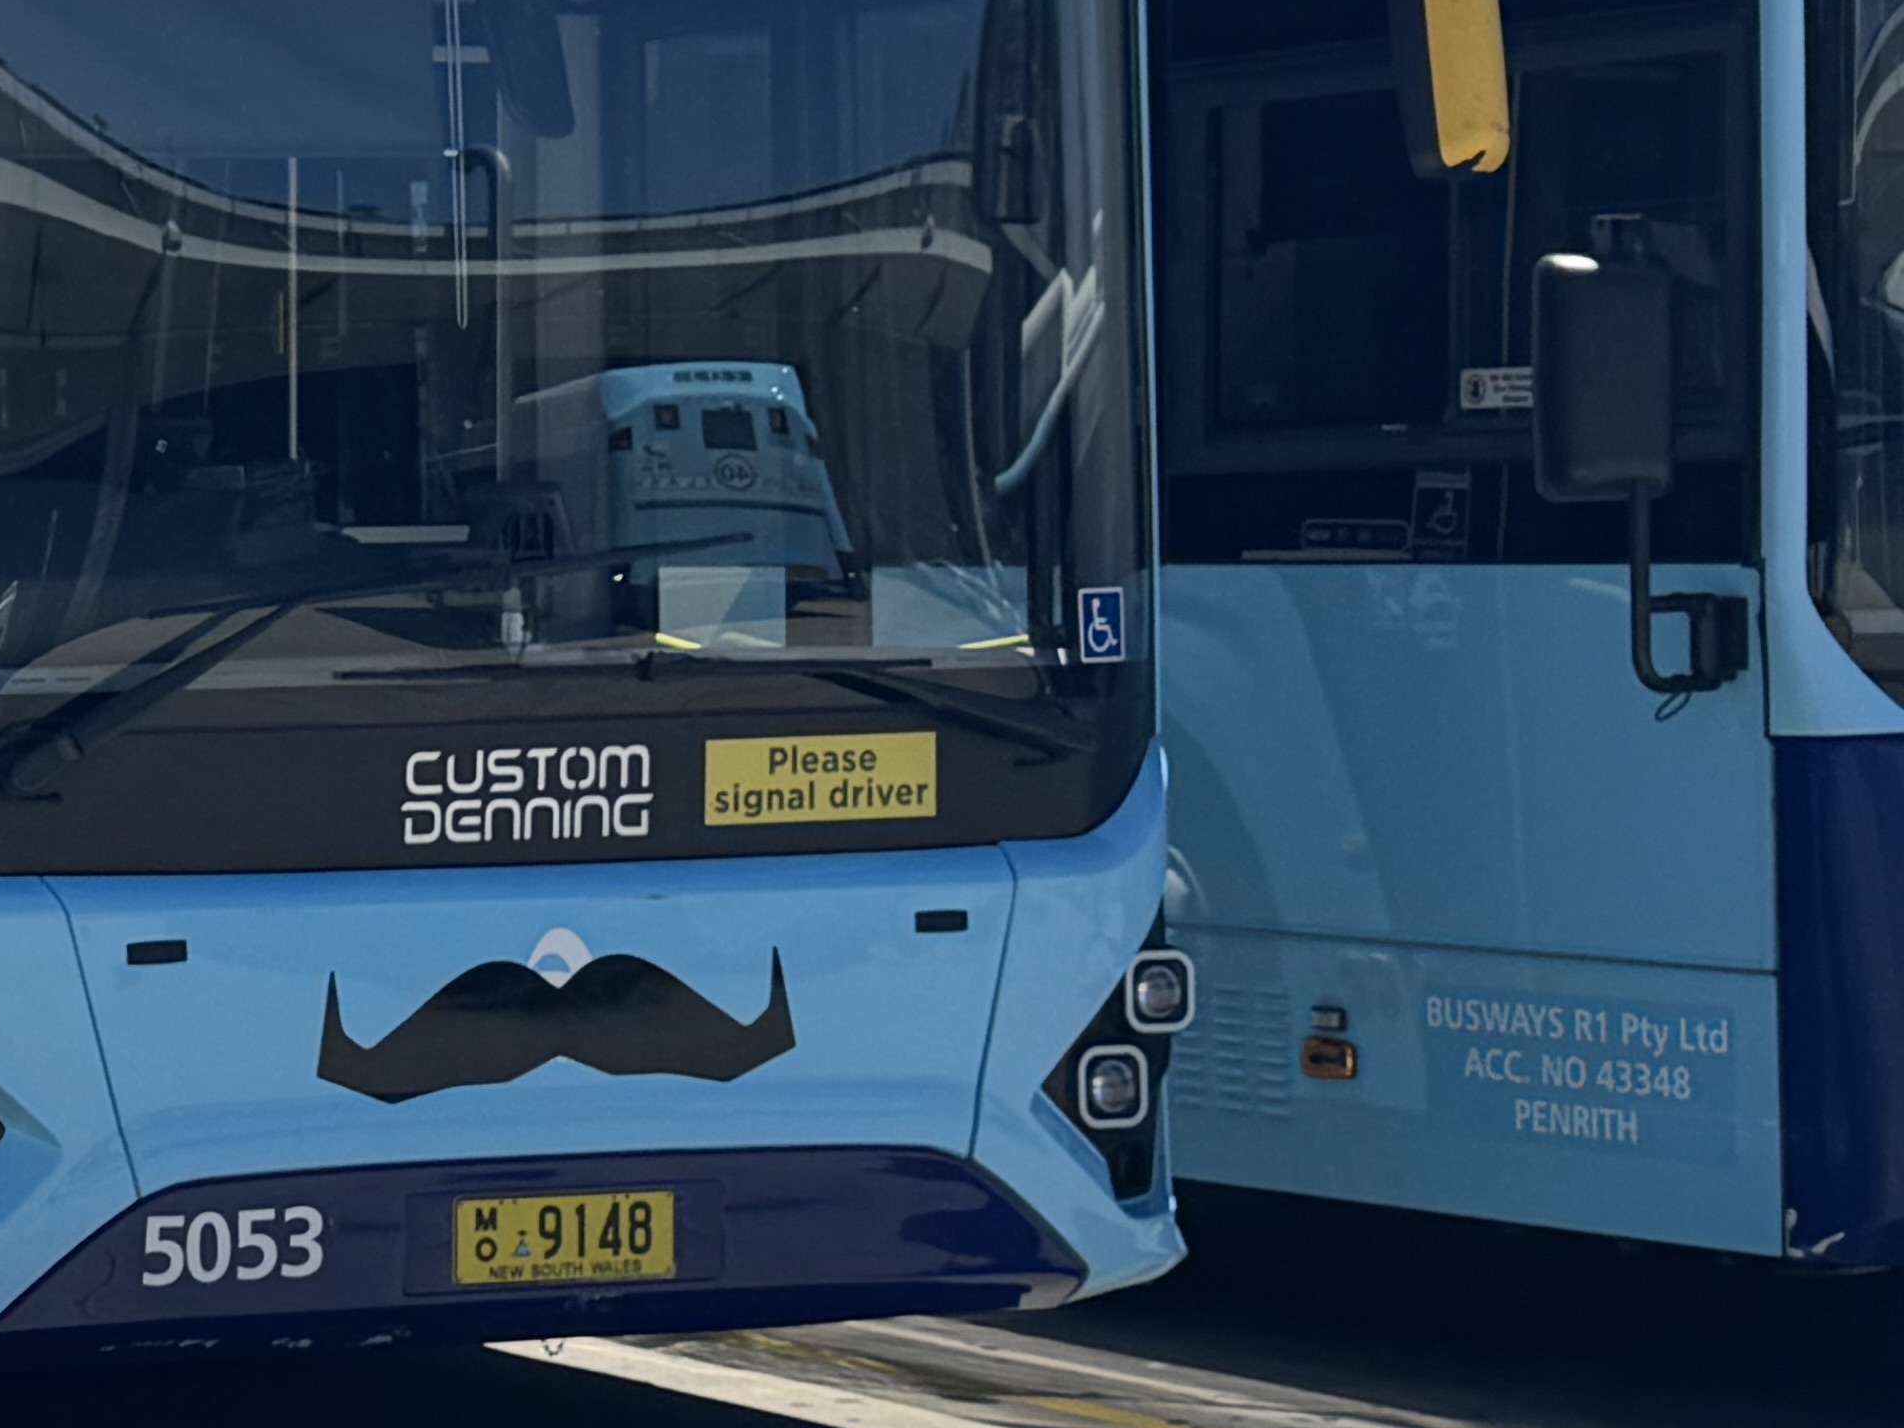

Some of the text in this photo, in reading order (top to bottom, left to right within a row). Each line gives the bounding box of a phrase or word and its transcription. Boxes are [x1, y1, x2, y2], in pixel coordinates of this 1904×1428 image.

[404, 743, 651, 795] CUSTOM
[767, 746, 878, 774] Please
[400, 791, 654, 845] DENNING
[713, 778, 929, 816] signal driver
[1427, 996, 1730, 1057] BUSWAYS R1 Pty Ltd
[1464, 1047, 1692, 1100] ACC. NO 43348
[1515, 1099, 1639, 1145] PENRITH
[142, 1206, 324, 1287] 5053
[536, 1202, 654, 1259] 9148
[489, 1259, 642, 1280] NEW SOUTH WALES
